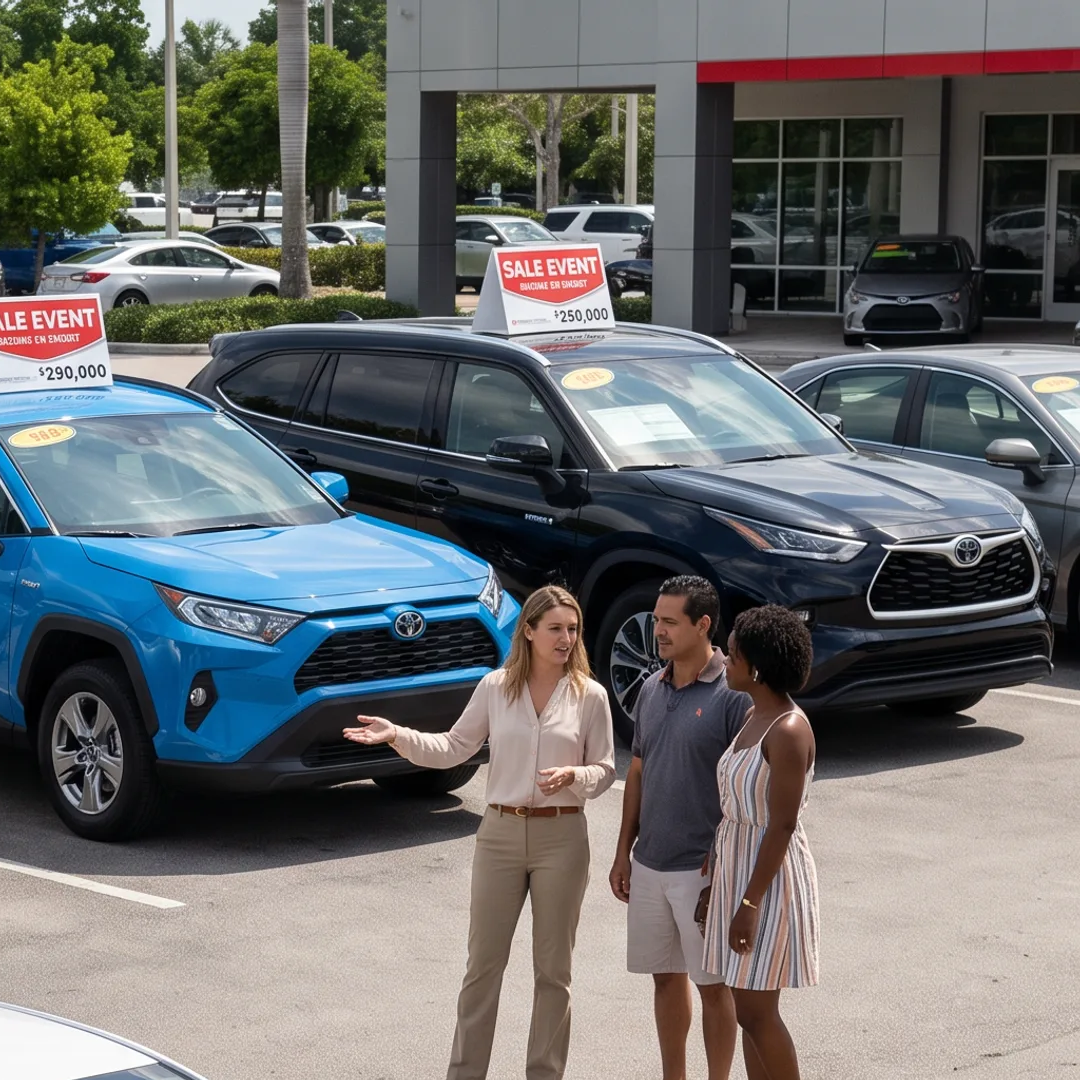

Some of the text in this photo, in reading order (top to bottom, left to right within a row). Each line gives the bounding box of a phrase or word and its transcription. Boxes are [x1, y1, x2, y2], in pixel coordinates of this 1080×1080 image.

[502, 256, 598, 279] SALE EVENT
[31, 308, 95, 330] EVENT
[38, 363, 107, 382] $290,000
